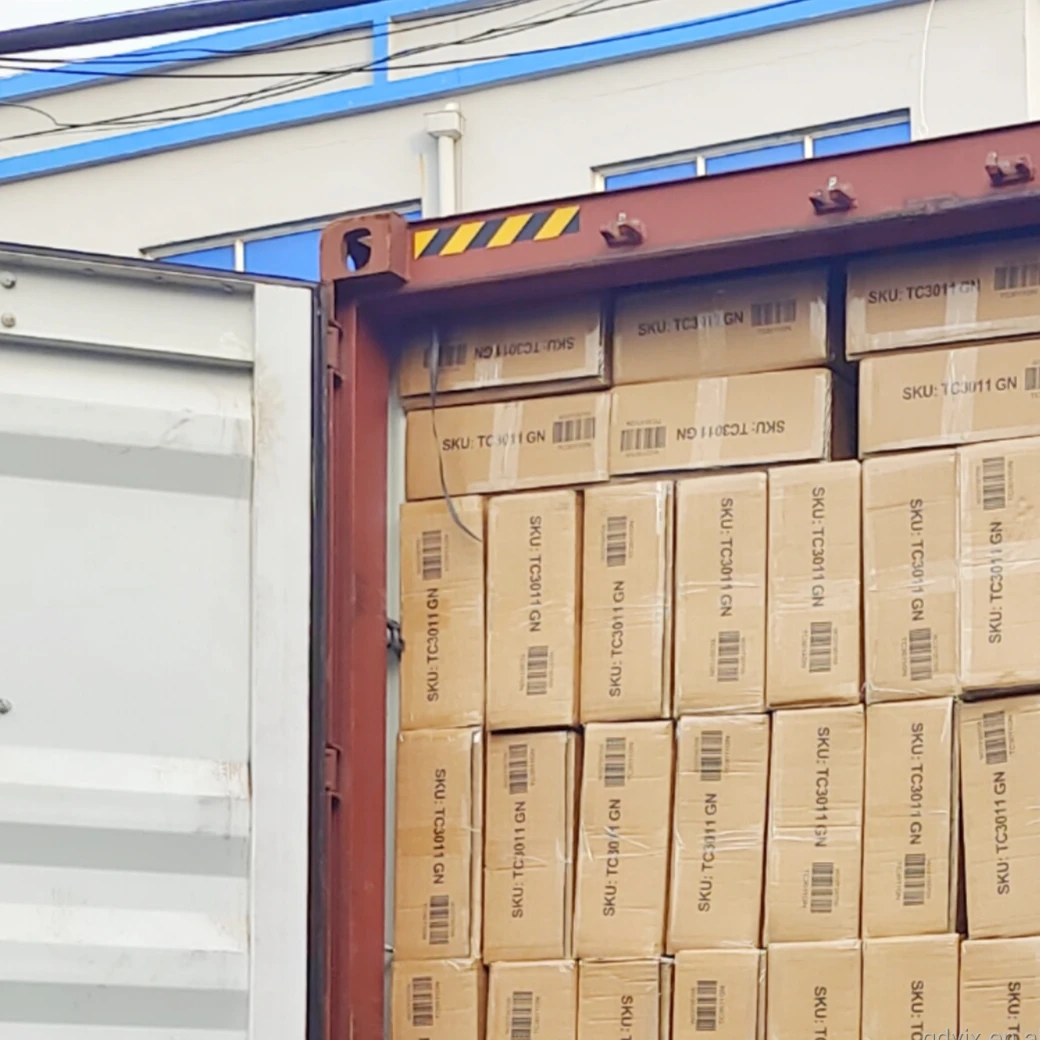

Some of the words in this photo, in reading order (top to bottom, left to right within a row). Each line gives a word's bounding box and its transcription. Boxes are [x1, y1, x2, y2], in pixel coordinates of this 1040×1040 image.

[473, 345, 494, 360] GN
[542, 336, 575, 352] SKU:
[676, 426, 698, 441] GN
[700, 422, 749, 439] TC3011
[751, 419, 786, 435] SKU:
[720, 497, 734, 534] SKU:
[811, 486, 826, 525] SKU:
[909, 498, 924, 536] SKU:
[528, 515, 542, 551] SKU:
[989, 521, 1004, 545] GN
[719, 537, 734, 591] TC3011
[811, 526, 825, 581] TC3011
[910, 539, 925, 593] TC3011
[529, 554, 542, 606] TC3011
[612, 580, 625, 604] GN
[989, 548, 1004, 604] TC3011
[426, 587, 440, 611] GN
[720, 593, 733, 618] GN
[811, 584, 825, 608] GN
[910, 597, 925, 622] GN
[426, 612, 440, 665] TC3011
[528, 608, 542, 633] GN
[610, 606, 625, 658] TC3011
[988, 605, 1003, 644] SKU:
[426, 665, 439, 702] SKU:
[608, 660, 622, 698] SKU:
[910, 722, 924, 759] SKU:
[433, 768, 447, 803] SKU:
[909, 763, 924, 818] TC3011
[993, 771, 1007, 796] GN
[704, 793, 718, 816] GN
[432, 807, 446, 858] TC3011
[909, 821, 923, 845] GN
[993, 799, 1009, 855] TC3011
[700, 819, 717, 873] TC3011
[432, 862, 445, 885] GN
[996, 856, 1010, 896] SKU:
[697, 874, 713, 912] SKU:
[910, 980, 925, 1018] SKU:
